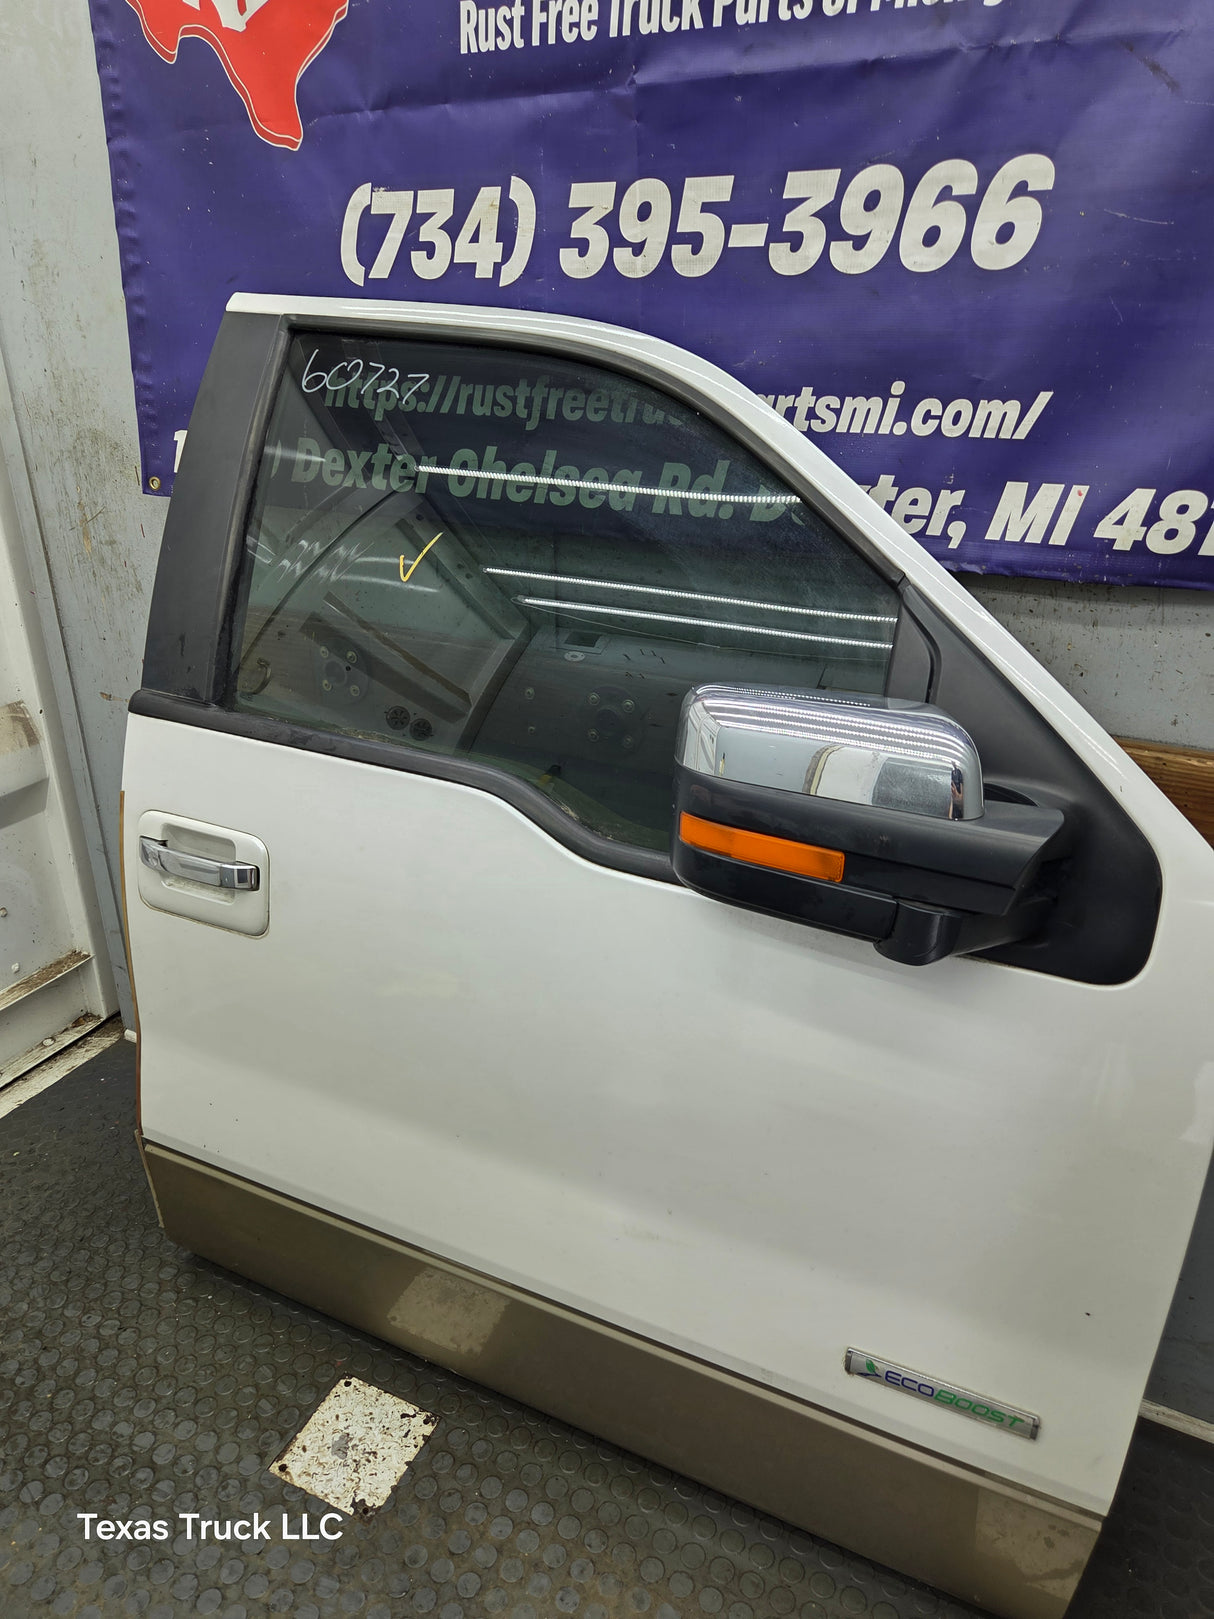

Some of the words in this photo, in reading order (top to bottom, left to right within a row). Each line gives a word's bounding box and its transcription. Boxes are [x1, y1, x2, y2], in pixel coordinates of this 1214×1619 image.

[460, 0, 525, 54] Rust
[531, 0, 598, 46] Free
[609, 0, 704, 37] Truck
[340, 175, 536, 287] (734)
[559, 153, 1056, 279] 395-3966
[301, 349, 429, 404] 60727
[291, 437, 438, 494] Dexter
[652, 459, 735, 520] Rd.
[985, 481, 1090, 546] MI
[884, 1370, 1026, 1428] ECOBOOST
